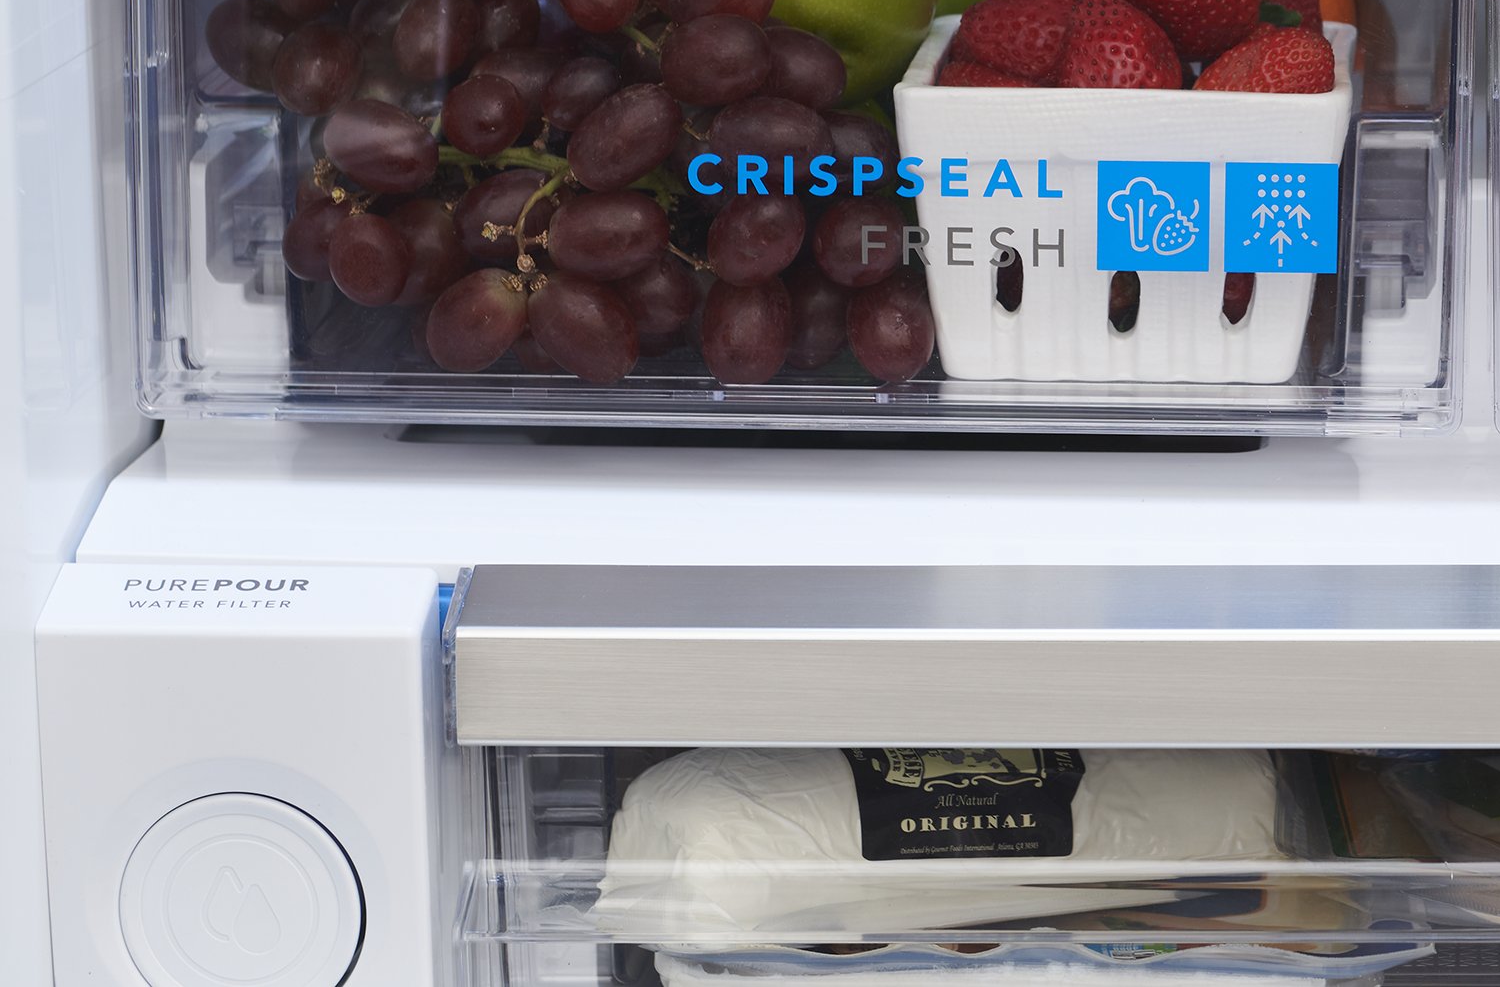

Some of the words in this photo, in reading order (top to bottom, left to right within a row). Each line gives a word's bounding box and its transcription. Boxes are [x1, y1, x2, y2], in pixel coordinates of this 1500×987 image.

[686, 153, 1065, 199] CRISPSEAL
[860, 225, 1067, 269] FRESH
[124, 579, 309, 591] PUREPOUR
[128, 600, 205, 608] WATER
[216, 600, 291, 608] FILTER
[934, 794, 953, 809] All
[955, 793, 999, 808] Natural
[900, 814, 1036, 833] ORIGINAL
